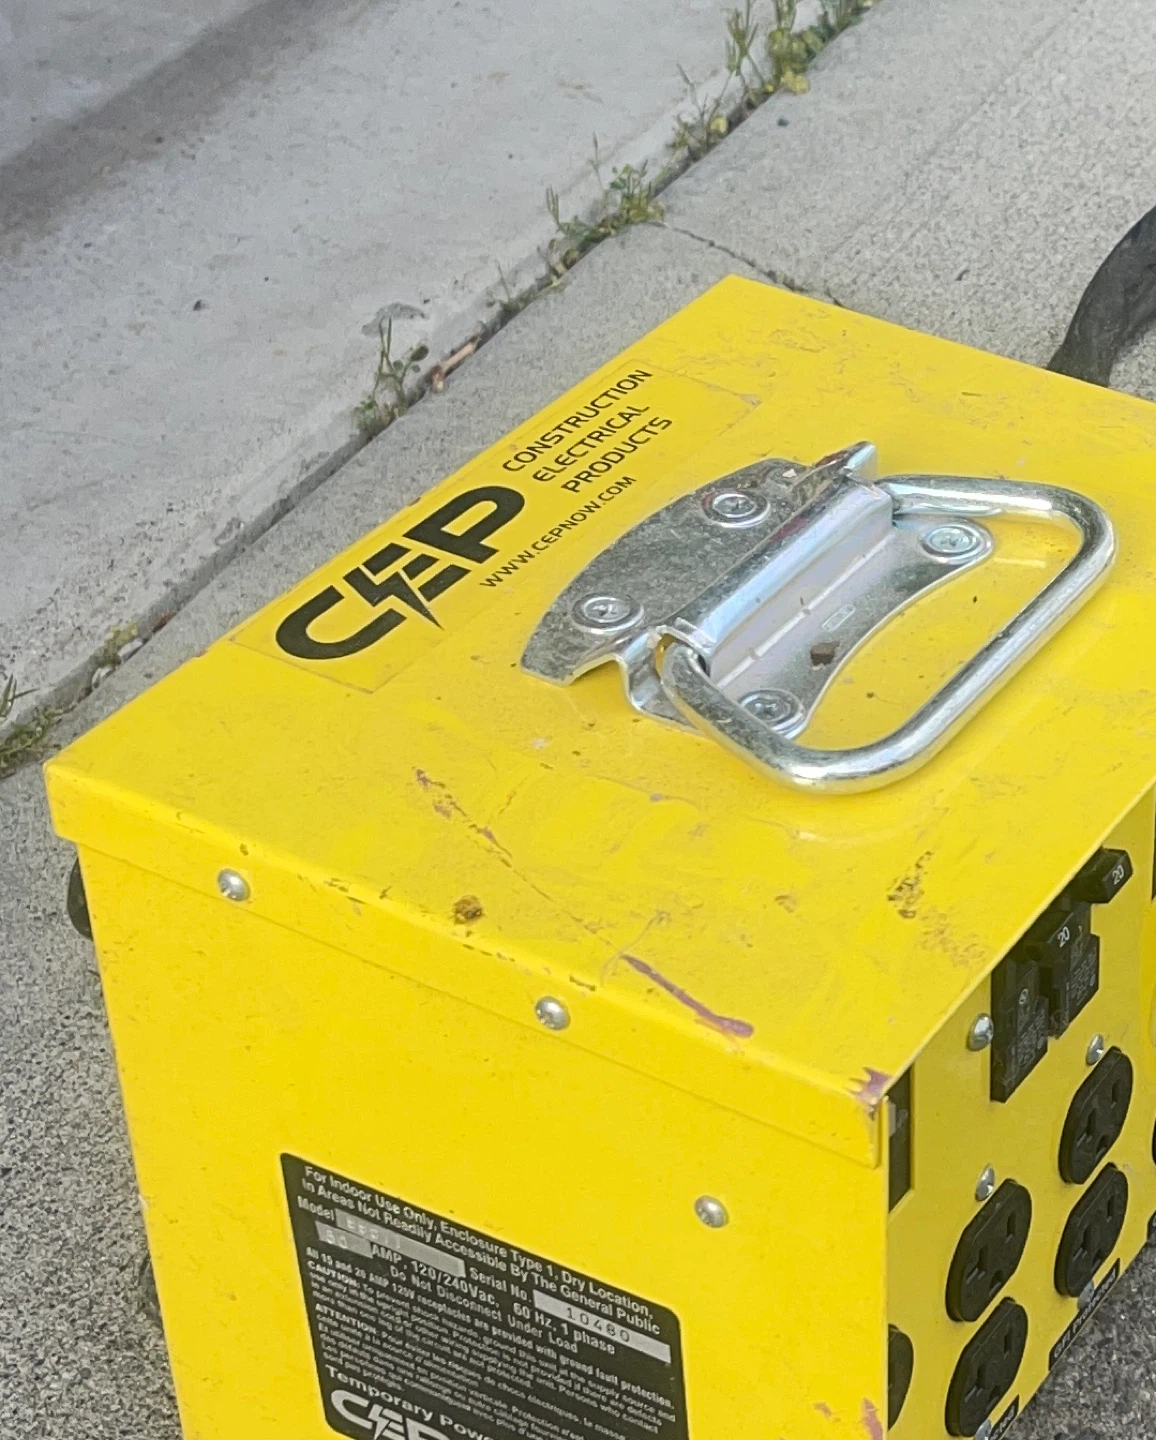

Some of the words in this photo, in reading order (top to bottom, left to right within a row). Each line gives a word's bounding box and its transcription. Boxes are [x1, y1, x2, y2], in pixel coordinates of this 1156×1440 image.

[502, 369, 653, 472] CONSTRUCTION
[532, 404, 651, 482] ELECTRICAL
[560, 417, 673, 493] PRODUCTS
[275, 485, 526, 661] CEP
[479, 476, 637, 589] WWW.CEPNOW.COM
[1112, 864, 1125, 885] 20
[1057, 926, 1070, 948] 20
[297, 1195, 333, 1219] Model
[469, 1267, 506, 1291] Serial
[510, 1283, 530, 1302] No.
[566, 1307, 631, 1343] 10480
[301, 1177, 315, 1192] In
[317, 1185, 354, 1208] Areas
[357, 1200, 380, 1219] Not
[383, 1211, 431, 1242] Readily
[435, 1233, 506, 1271] Accessible
[509, 1263, 527, 1281] By
[532, 1272, 556, 1291] The
[559, 1284, 612, 1315] General
[616, 1307, 659, 1334] Public
[304, 1165, 326, 1186] For
[329, 1175, 371, 1201] Indoor
[374, 1194, 400, 1214] Use
[402, 1206, 436, 1230] Only,
[439, 1220, 507, 1257] Enclosure
[510, 1249, 542, 1272] Type
[561, 1270, 585, 1291] Dry
[389, 1264, 406, 1281] Do
[410, 1274, 431, 1292] Not
[436, 1284, 501, 1321] Disconnect
[507, 1314, 542, 1337] Under
[547, 1331, 577, 1353] Load
[491, 1325, 533, 1349] provided
[535, 1344, 557, 1359] with
[513, 1302, 530, 1319] 60
[560, 1322, 568, 1335] 1
[573, 1330, 614, 1354] phase
[325, 1364, 432, 1420] Temporary
